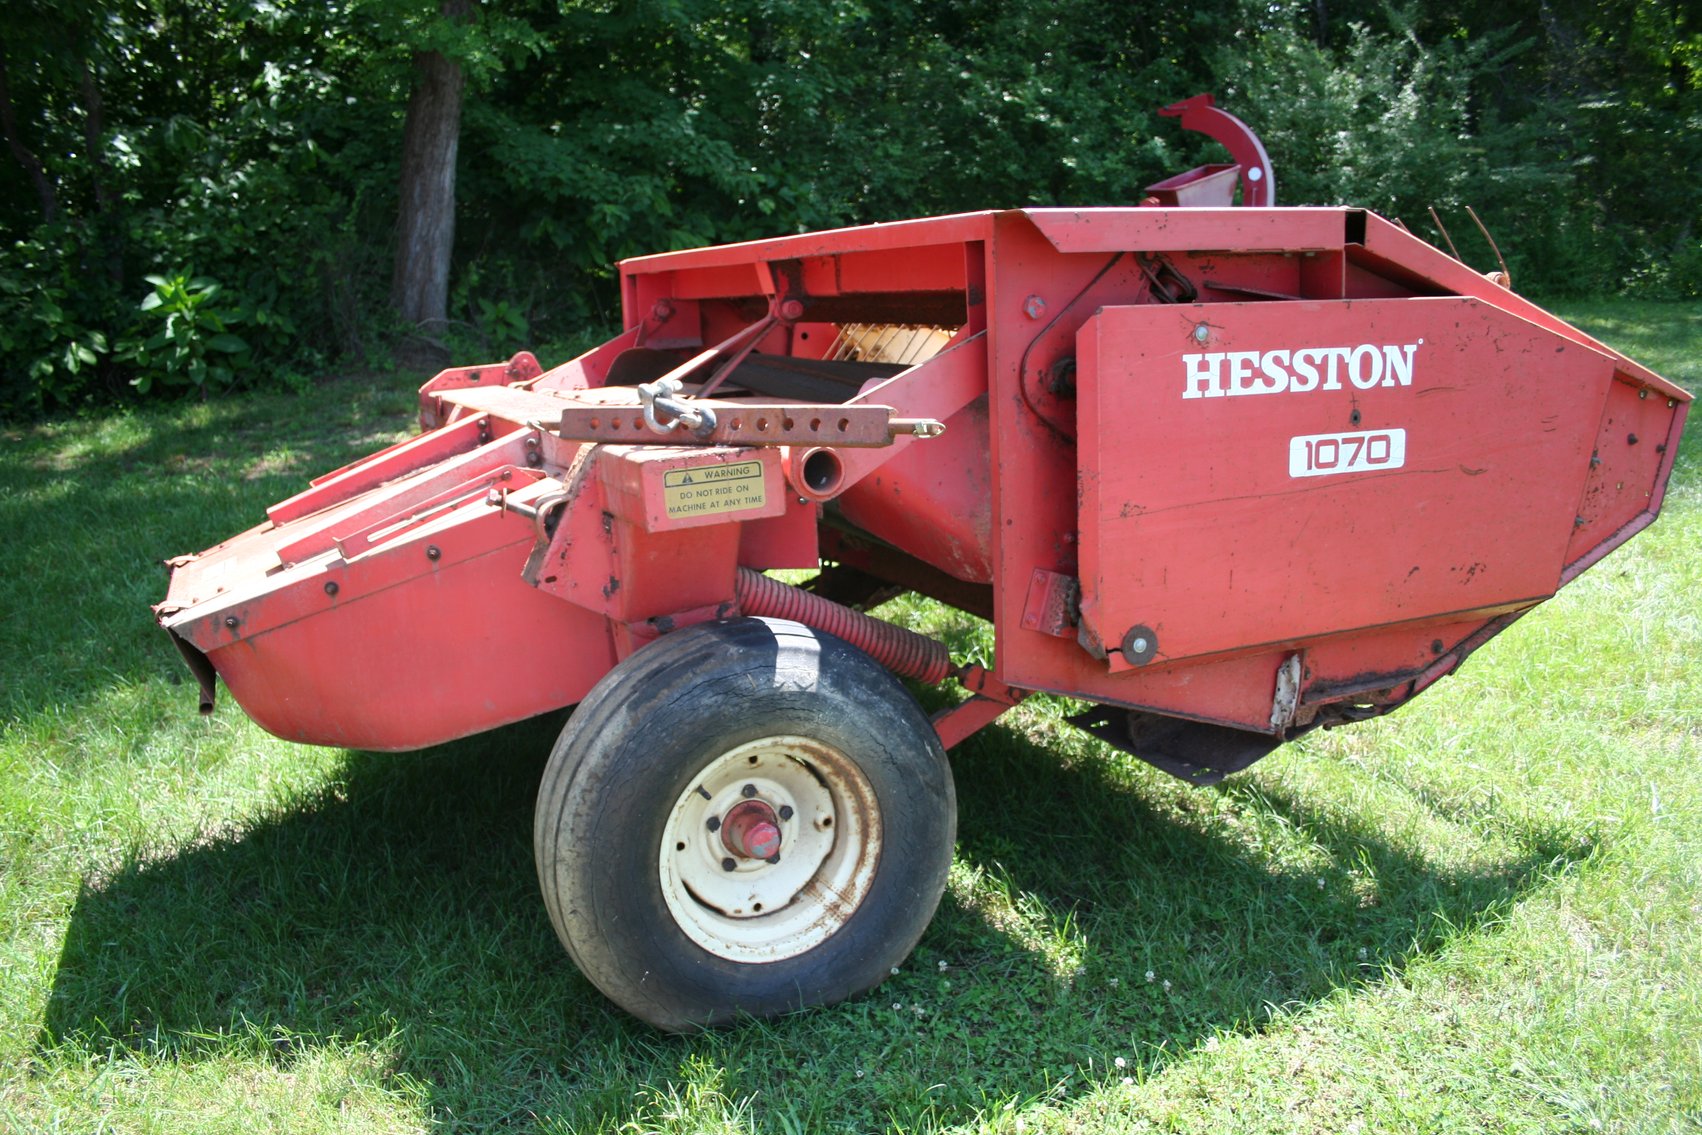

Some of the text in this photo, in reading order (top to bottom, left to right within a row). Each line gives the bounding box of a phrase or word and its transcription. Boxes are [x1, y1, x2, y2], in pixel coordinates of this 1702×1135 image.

[1182, 344, 1417, 399] HESSTON
[1305, 434, 1391, 470] 1070
[704, 466, 750, 478] WARNING
[680, 484, 749, 500] DO NOT RIDE ON
[669, 502, 706, 513] MACHINE
[724, 498, 741, 506] ANY
